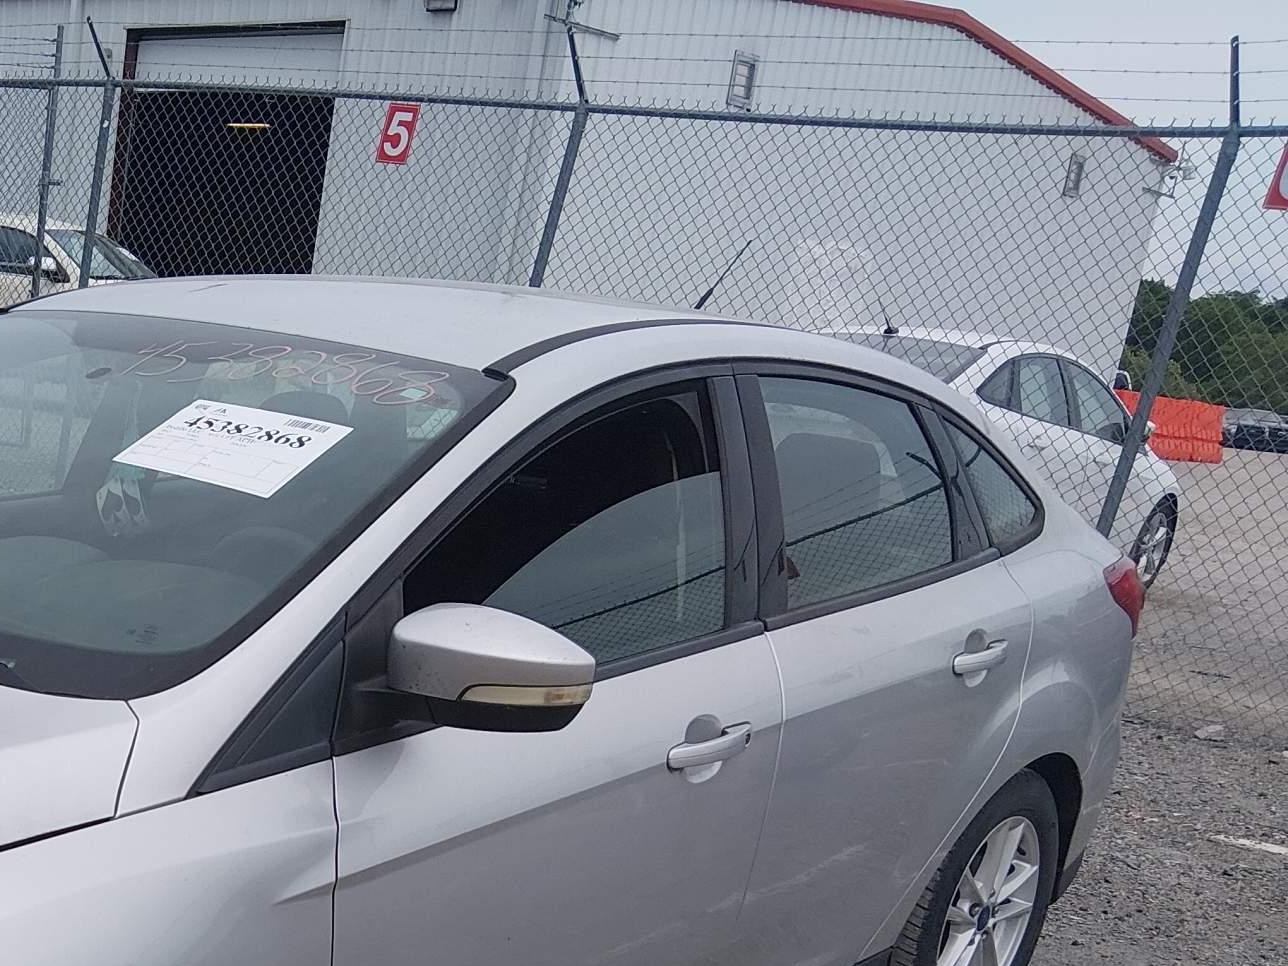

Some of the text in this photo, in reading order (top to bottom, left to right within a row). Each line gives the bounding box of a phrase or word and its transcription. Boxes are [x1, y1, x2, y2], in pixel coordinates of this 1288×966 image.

[383, 112, 413, 157] 5
[120, 340, 450, 406] 45382868
[184, 415, 312, 449] 45382868
